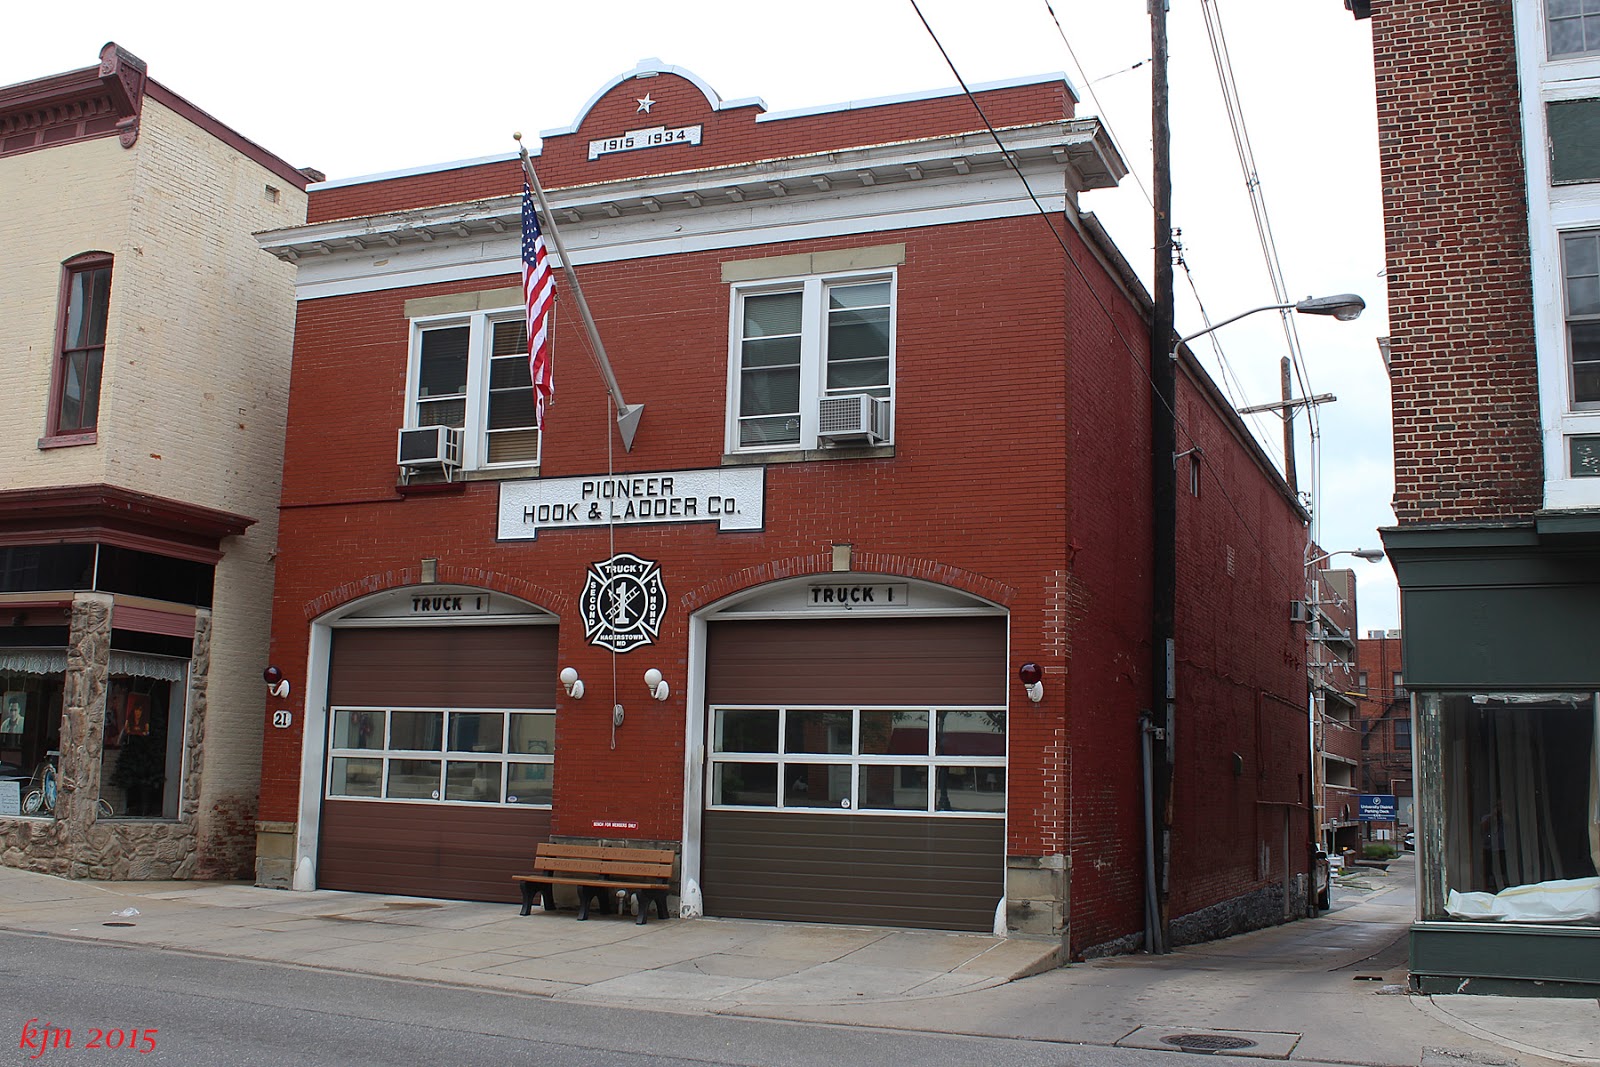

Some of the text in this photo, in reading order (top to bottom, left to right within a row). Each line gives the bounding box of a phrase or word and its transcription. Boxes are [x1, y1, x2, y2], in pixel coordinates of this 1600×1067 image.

[603, 130, 686, 151] 1915 1934
[582, 477, 674, 500] PIONEER
[523, 502, 580, 523] HOOK
[588, 502, 602, 519] &
[611, 497, 697, 519] LADDER
[605, 564, 644, 574] TRUCK 1
[412, 596, 462, 612] TRUCK
[588, 581, 597, 626] SECOND
[811, 586, 874, 603] TRUCK
[274, 712, 287, 726] 21
